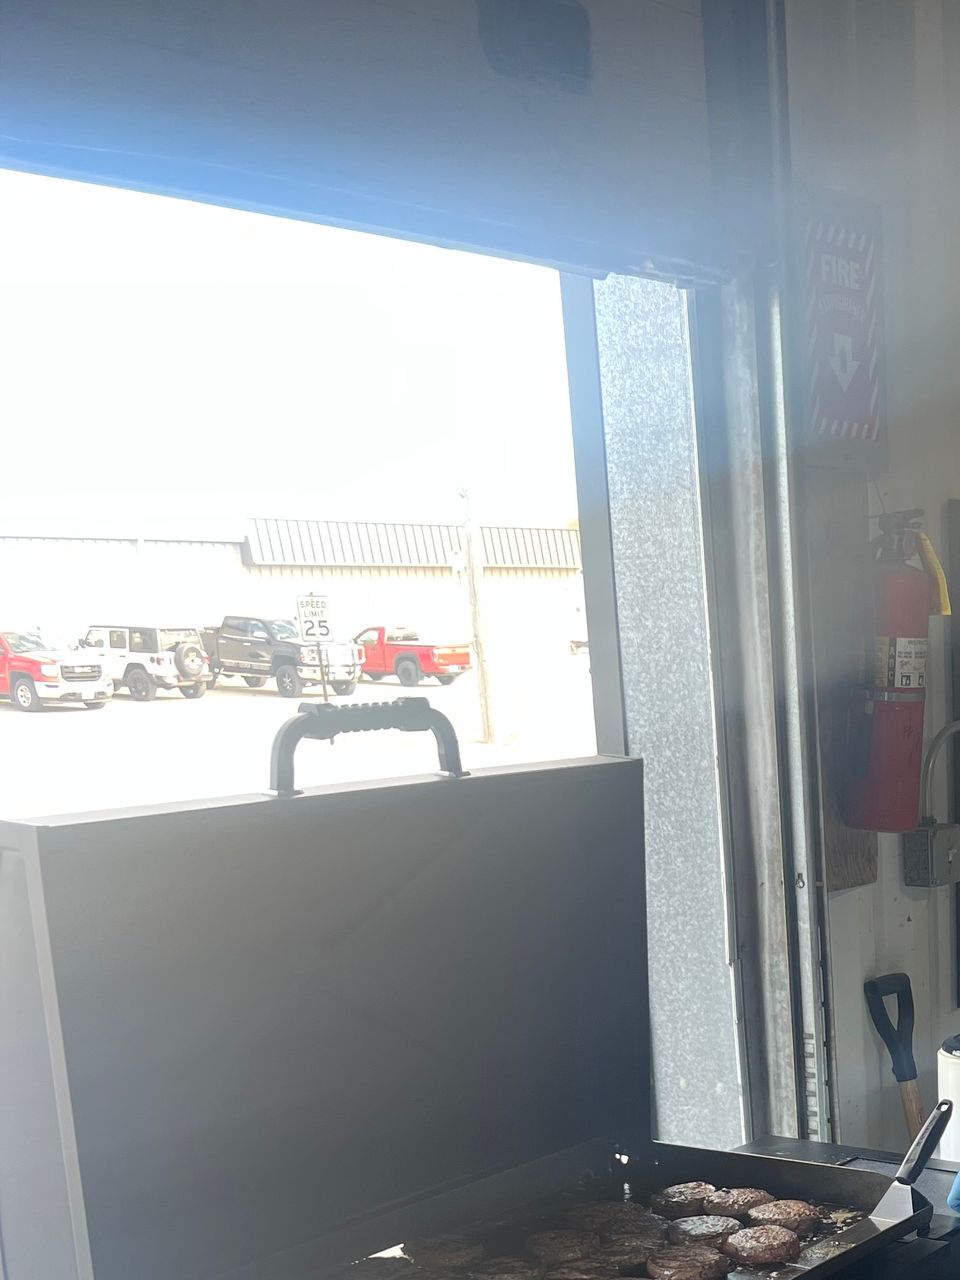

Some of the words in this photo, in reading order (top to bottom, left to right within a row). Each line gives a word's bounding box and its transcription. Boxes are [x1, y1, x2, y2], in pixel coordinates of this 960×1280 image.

[820, 253, 860, 290] FIRE
[300, 600, 327, 609] SPEED
[304, 610, 324, 618] LIMIT
[304, 620, 330, 636] 25
